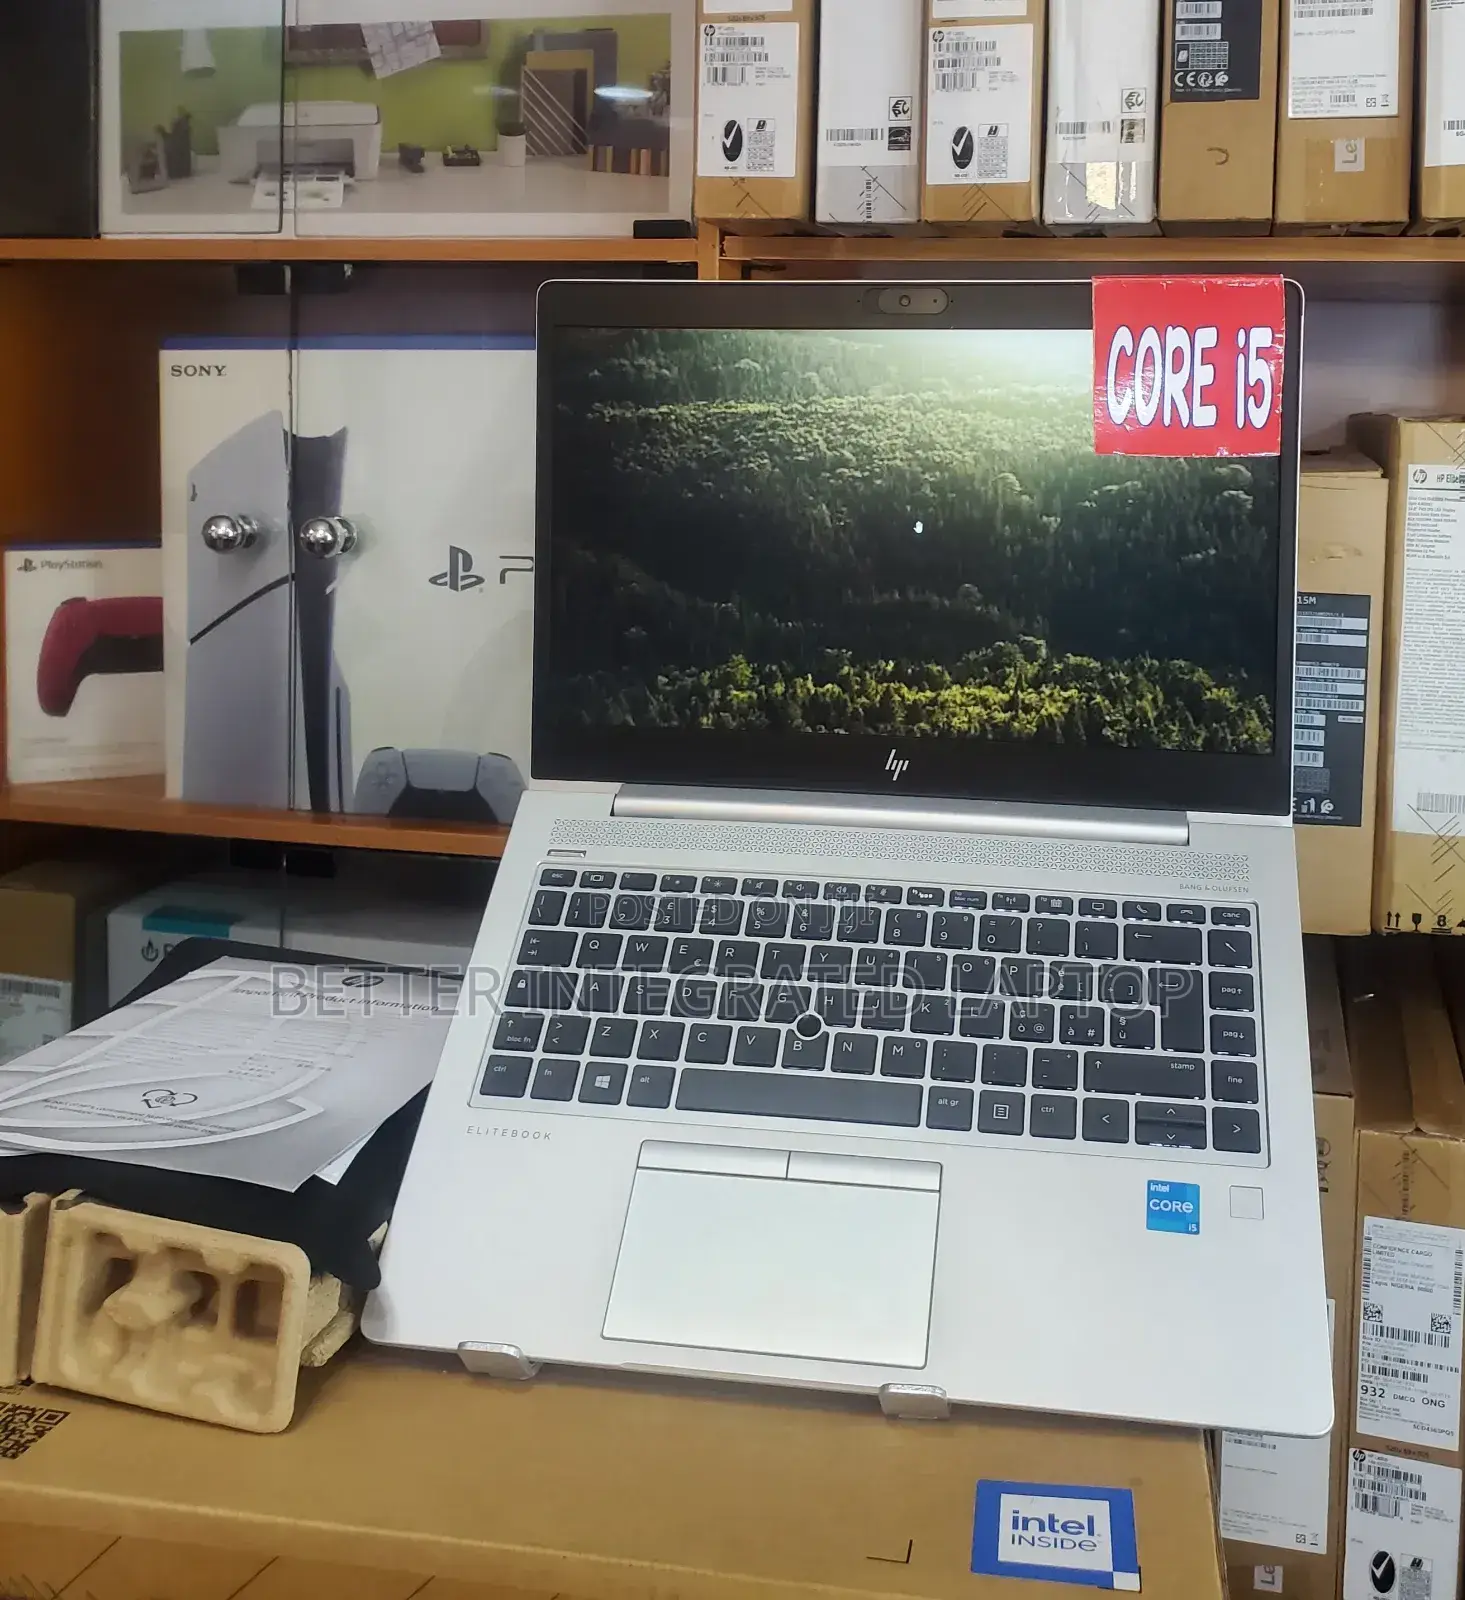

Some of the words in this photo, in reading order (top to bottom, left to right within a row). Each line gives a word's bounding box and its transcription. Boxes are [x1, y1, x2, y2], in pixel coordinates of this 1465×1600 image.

[170, 364, 226, 377] SONY
[1106, 325, 1218, 428] CORE
[1236, 325, 1273, 429] i5
[40, 559, 103, 570] PlayStation
[1212, 886, 1249, 894] OLUFSEN
[1222, 911, 1241, 919] canc
[1437, 914, 1447, 927] 8
[589, 939, 600, 950] Q
[635, 942, 649, 952] W
[679, 945, 689, 955] E
[725, 947, 735, 958] R
[772, 950, 780, 960] T
[819, 952, 829, 962] Y
[866, 956, 876, 966] U
[1009, 966, 1019, 975] P
[589, 982, 600, 991] A
[636, 984, 645, 995] S
[682, 987, 692, 997] D
[728, 990, 738, 1000] F
[777, 993, 787, 1003] G
[824, 996, 834, 1006] H
[872, 999, 880, 1009] J
[921, 1003, 931, 1013] K
[601, 1026, 612, 1037] Z
[1033, 1023, 1045, 1034] @
[1087, 1028, 1096, 1037] #
[649, 1029, 659, 1040] X
[697, 1032, 708, 1042] C
[1223, 1031, 1238, 1039] pag
[746, 1035, 756, 1045] V
[793, 1041, 803, 1051] B
[842, 1042, 853, 1052] N
[892, 1046, 904, 1056] M
[1170, 1062, 1196, 1071] stamp
[544, 1068, 553, 1076] fn
[639, 1075, 650, 1083] alt
[1227, 1075, 1243, 1084] fine
[950, 1099, 960, 1107] gr
[467, 1125, 552, 1140] ELITEBOOK
[1150, 1182, 1170, 1193] intel
[1188, 1224, 1198, 1233] i5
[1360, 1384, 1386, 1399] 932
[1393, 1393, 1416, 1403] DMCQ
[1421, 1397, 1446, 1408] ONG
[1011, 1509, 1095, 1537] intel
